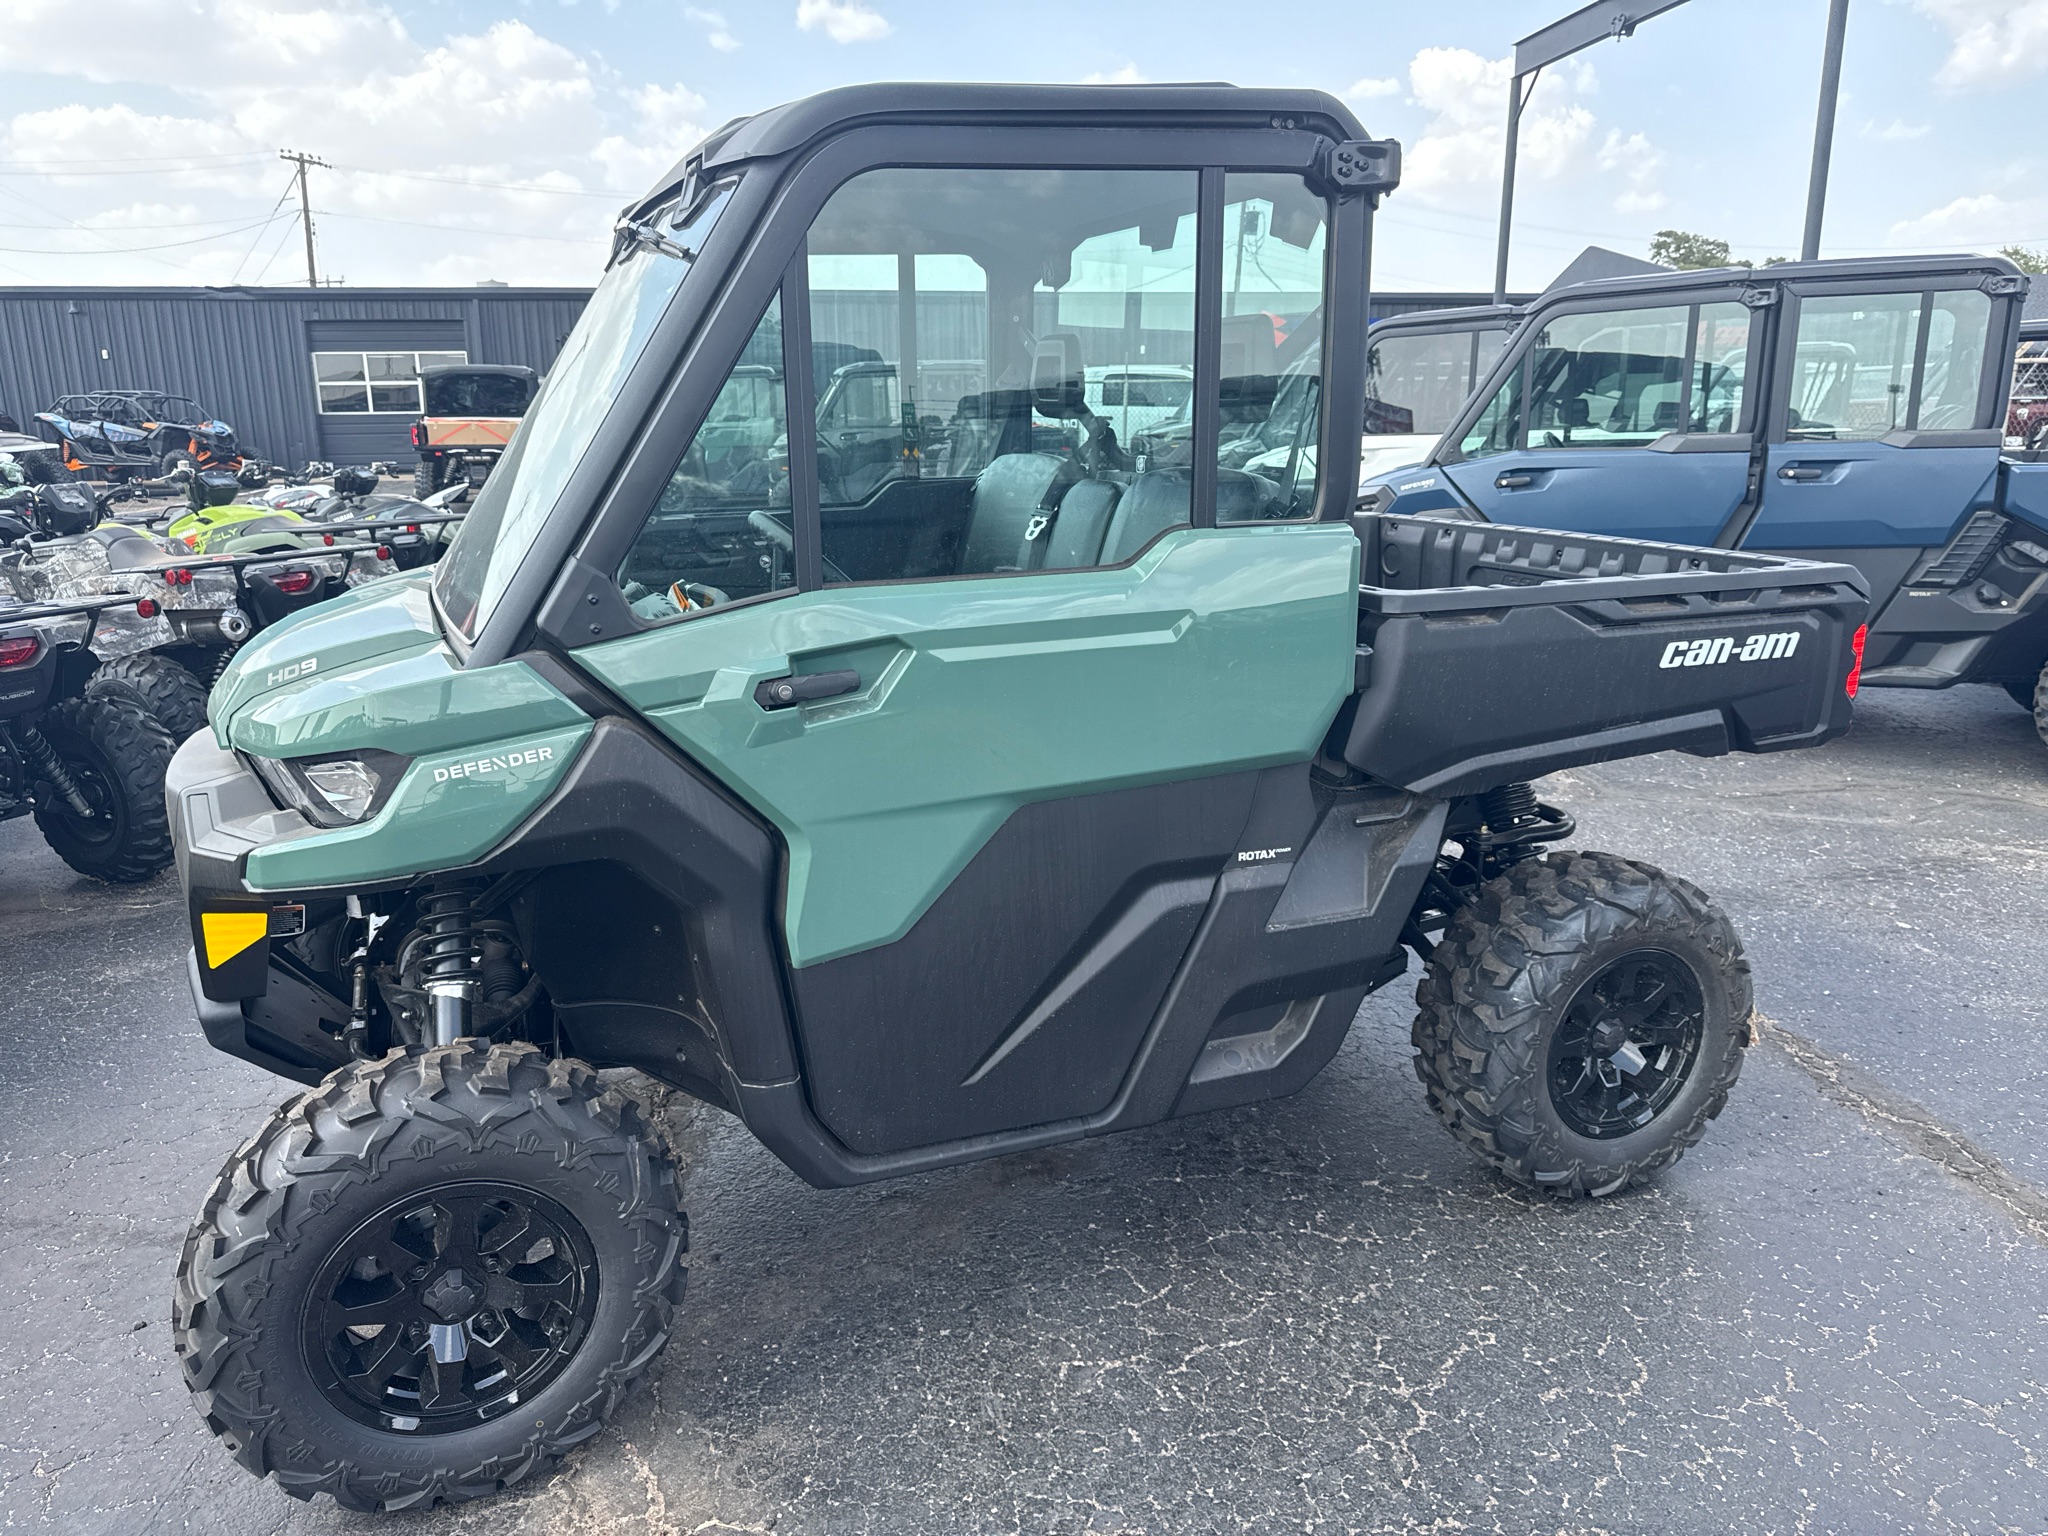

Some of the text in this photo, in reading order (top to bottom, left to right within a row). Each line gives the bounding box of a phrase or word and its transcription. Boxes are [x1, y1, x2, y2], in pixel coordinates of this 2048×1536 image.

[176, 527, 197, 540] YAMAHA
[191, 527, 238, 554] RIZZLY
[1659, 631, 1801, 669] can-am
[267, 657, 317, 686] HD9
[433, 747, 553, 782] DEFENDER
[1238, 849, 1276, 861] ROTAX
